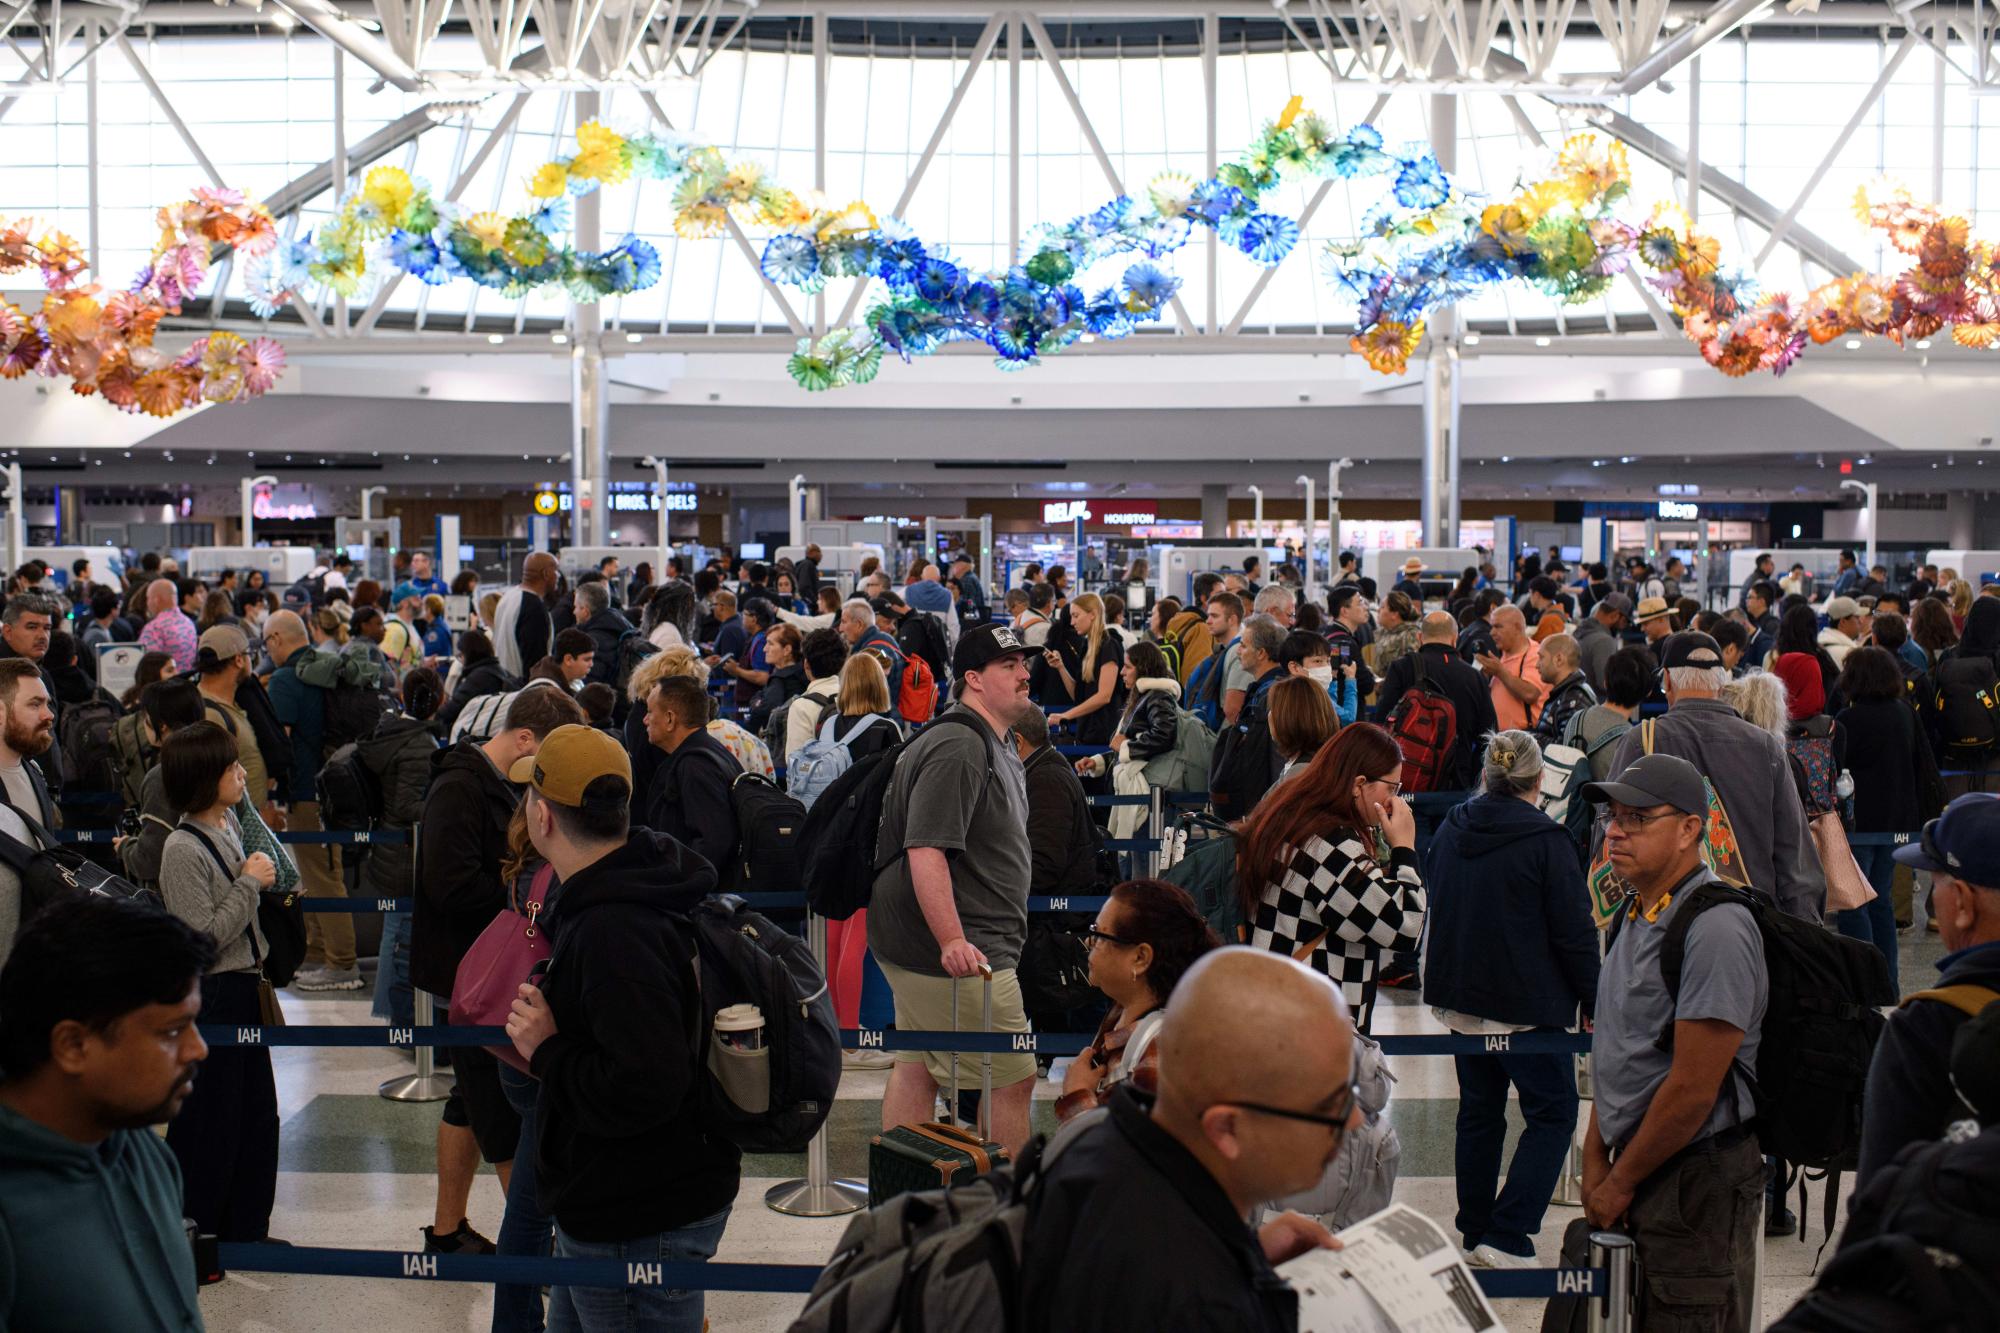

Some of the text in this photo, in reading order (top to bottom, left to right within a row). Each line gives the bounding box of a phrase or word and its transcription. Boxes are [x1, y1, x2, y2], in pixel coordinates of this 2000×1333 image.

[615, 494, 697, 511] BROS. BGELS
[1103, 513, 1155, 525] HOUSTON
[77, 831, 93, 841] IAH
[354, 832, 370, 842] IAH
[1894, 833, 1909, 843] IAH
[377, 899, 396, 911] IAH
[1050, 898, 1068, 910] IAH
[238, 1028, 260, 1042] IAH
[390, 1029, 412, 1043] IAH
[860, 1031, 882, 1046] IAH
[1013, 1035, 1036, 1049] IAH
[1486, 1036, 1509, 1050] IAH
[404, 1255, 437, 1276] IAH
[628, 1263, 662, 1284] IAH
[1558, 1271, 1592, 1292] IAH
